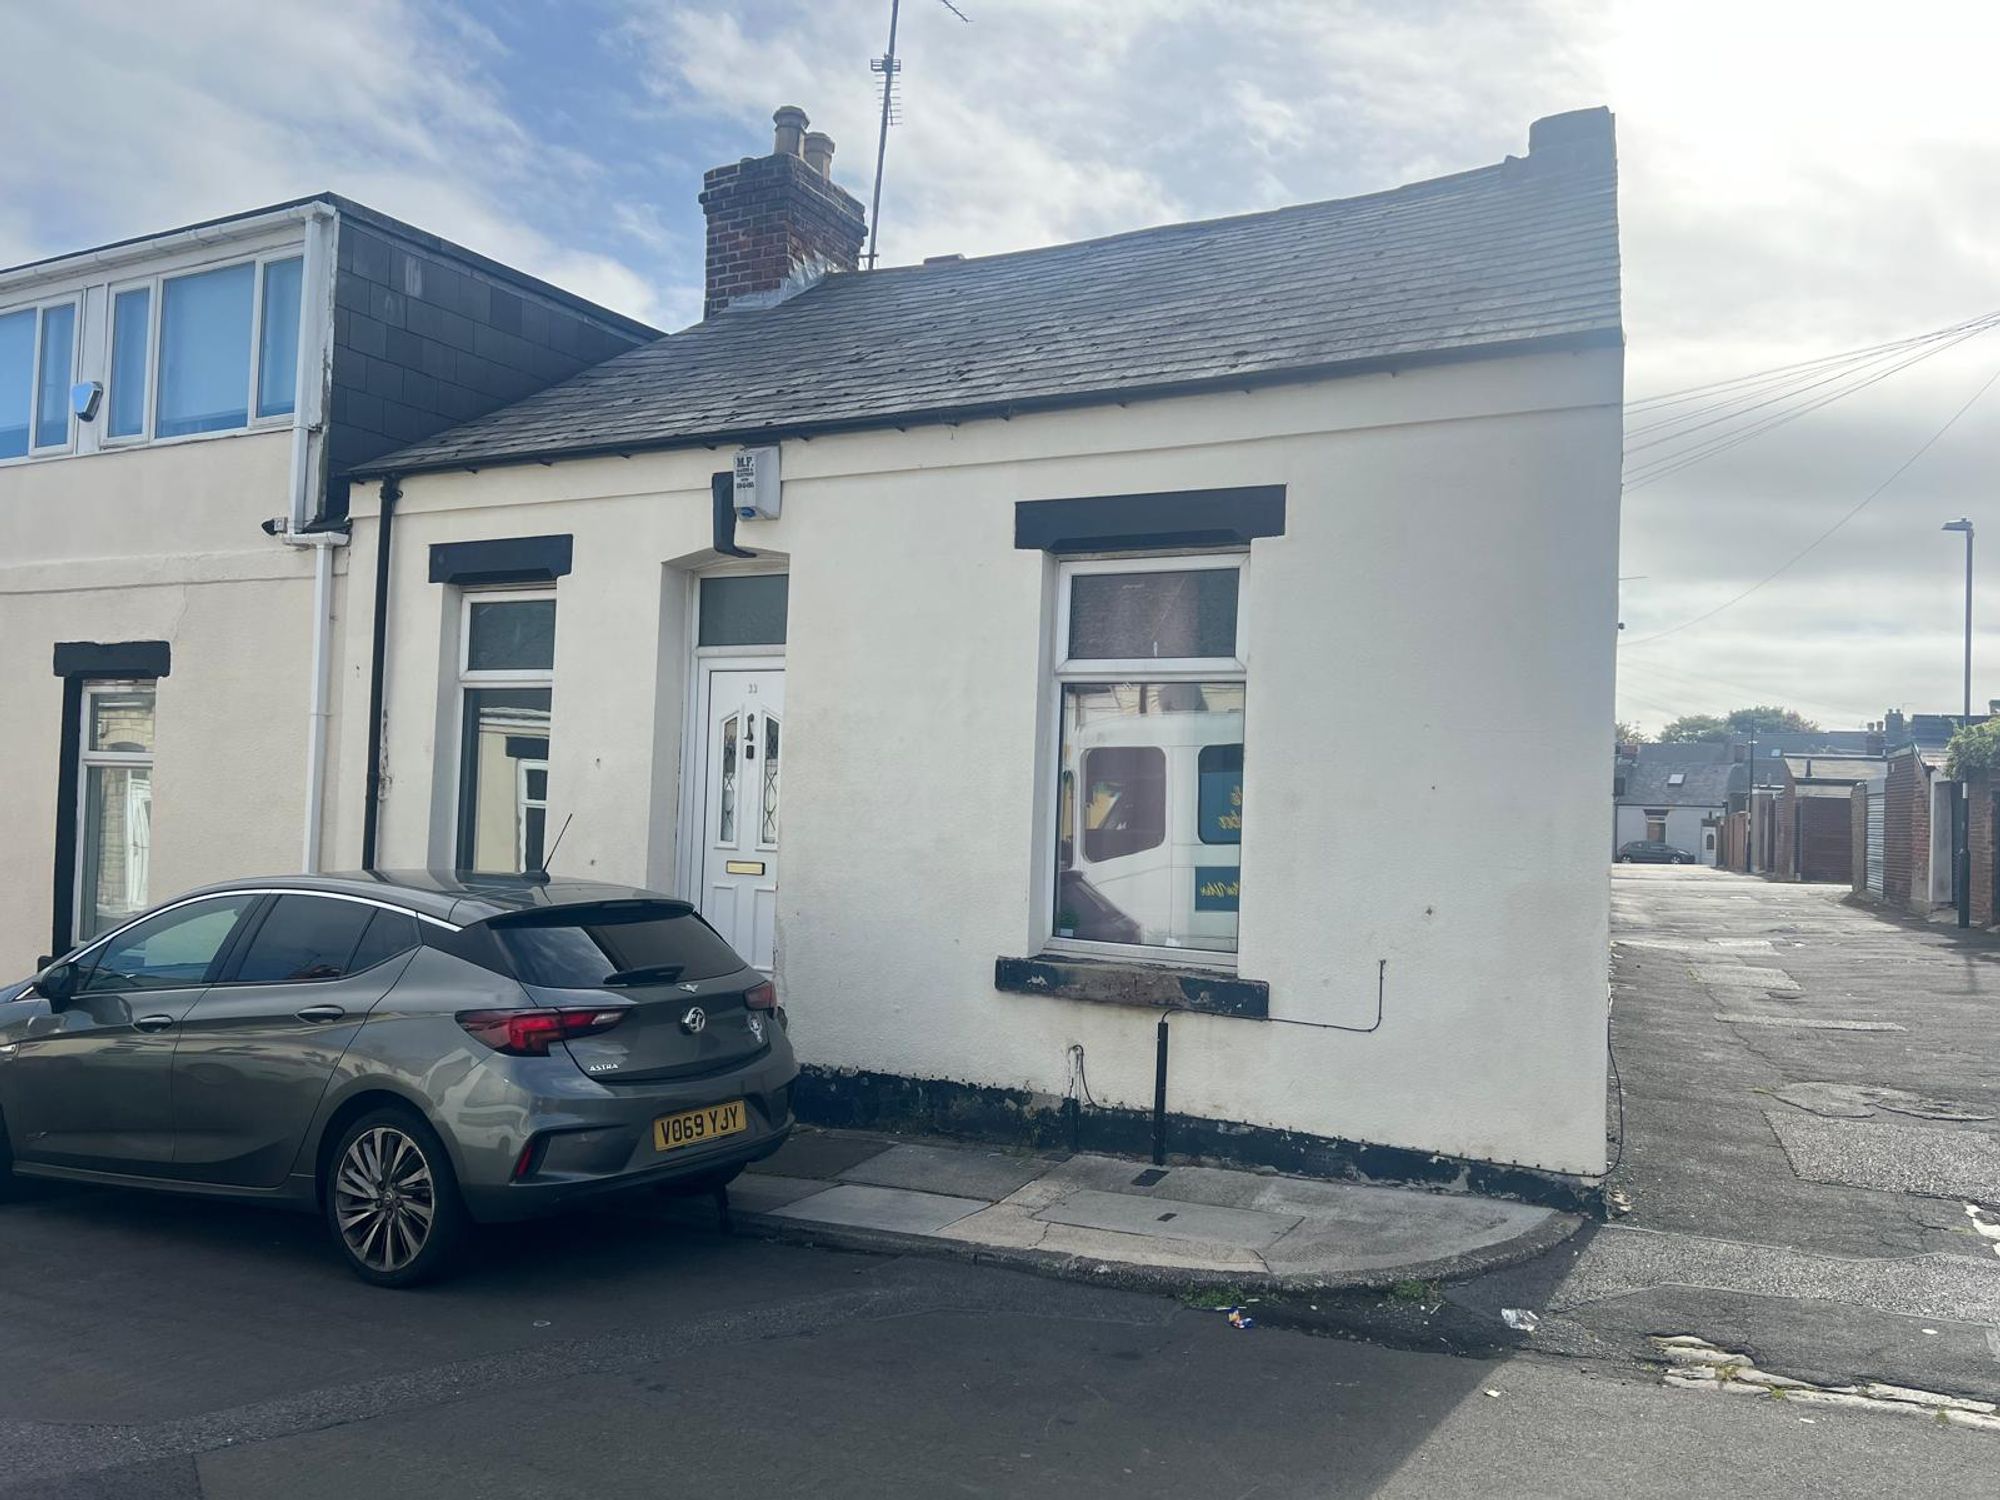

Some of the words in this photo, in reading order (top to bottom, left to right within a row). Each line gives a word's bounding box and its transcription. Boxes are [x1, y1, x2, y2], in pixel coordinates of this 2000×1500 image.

[589, 1063, 619, 1072] ASTRA
[661, 1113, 705, 1145] VO69
[708, 1105, 738, 1133] YJY
